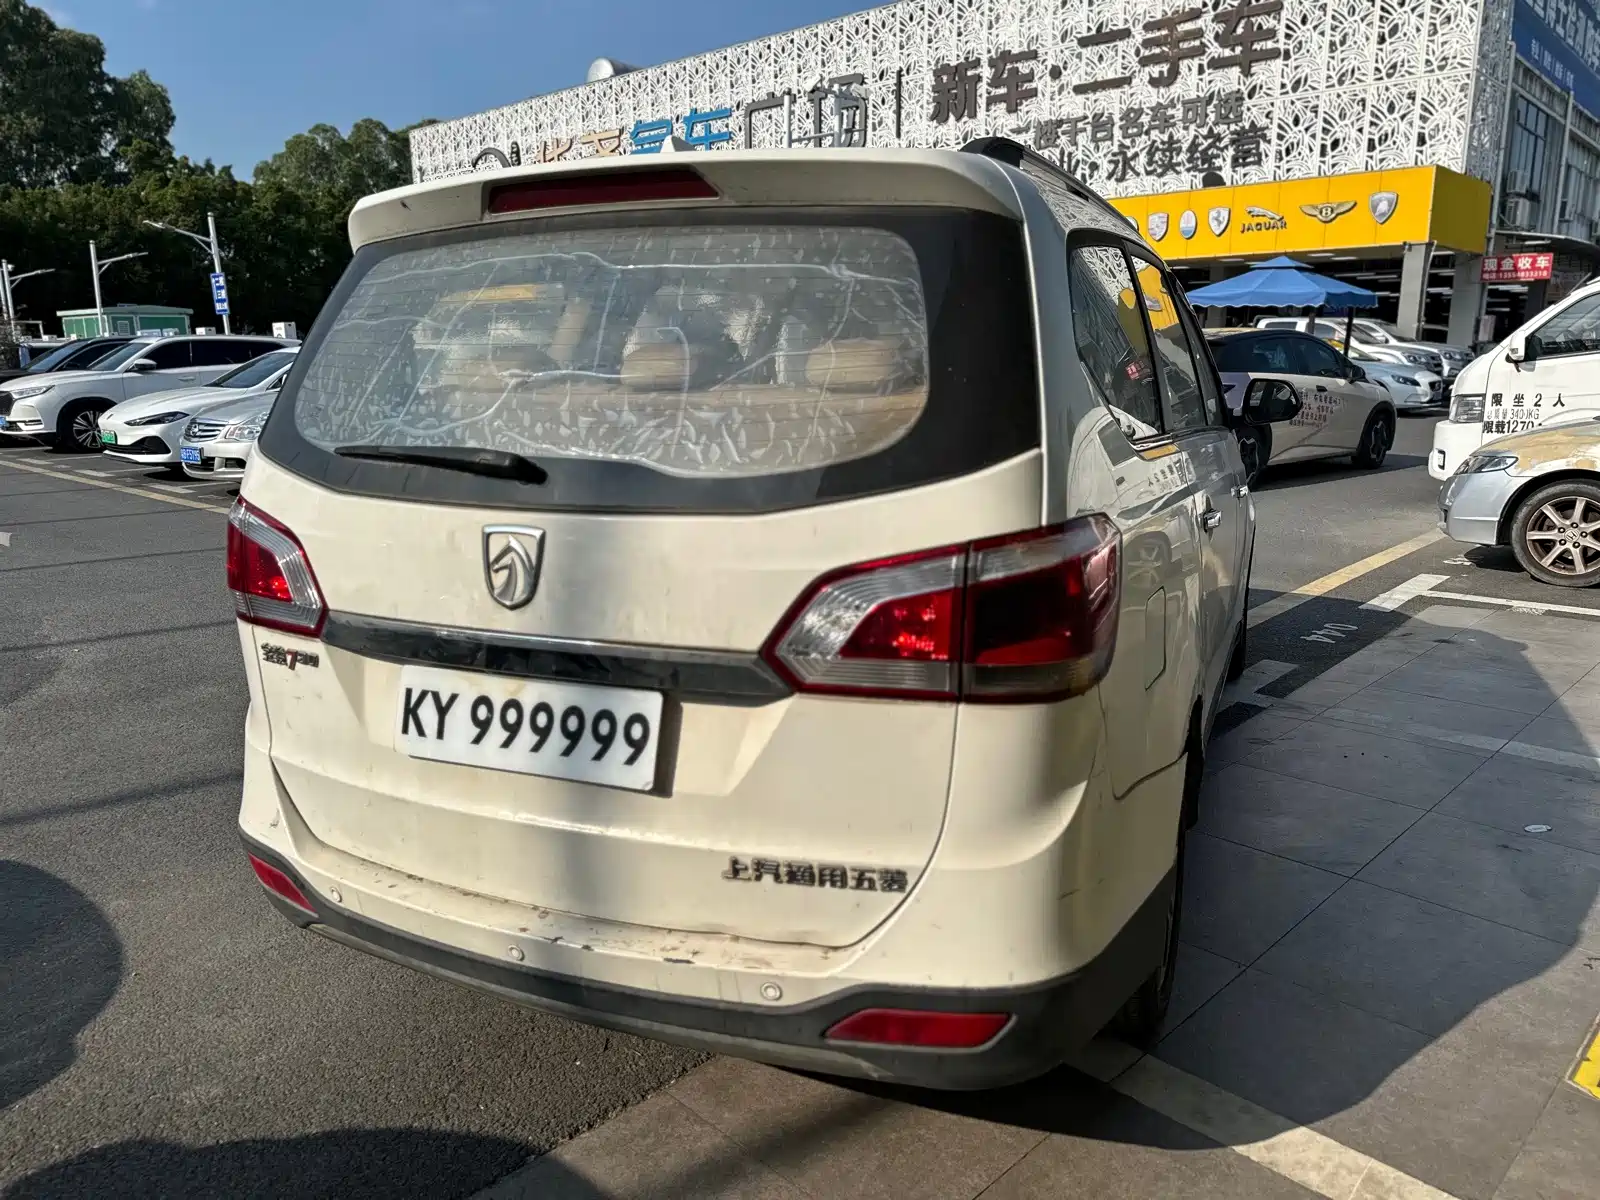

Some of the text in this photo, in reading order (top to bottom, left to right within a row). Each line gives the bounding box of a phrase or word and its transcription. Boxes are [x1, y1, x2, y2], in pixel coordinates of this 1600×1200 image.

[1240, 220, 1288, 234] JAGUAR
[1483, 256, 1550, 271] 现金收车
[401, 687, 650, 766] KY 999999
[721, 856, 908, 893] 上汽通用五菱
